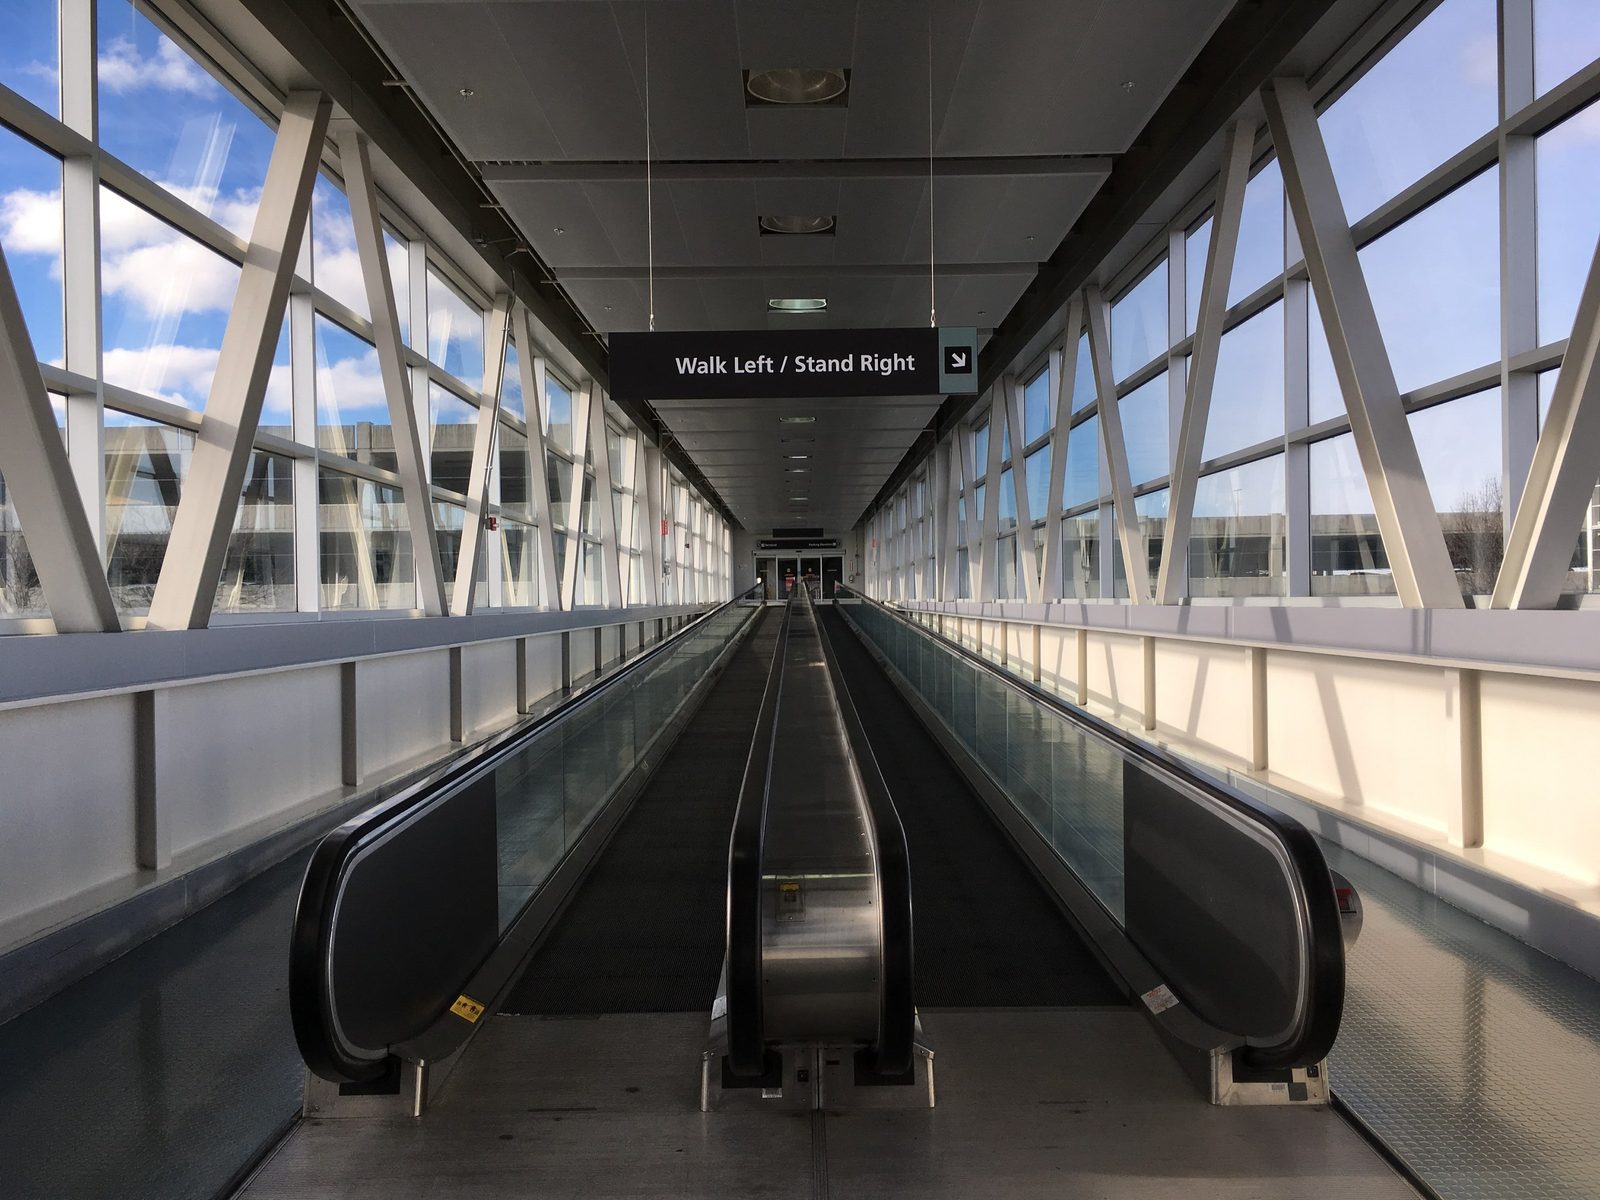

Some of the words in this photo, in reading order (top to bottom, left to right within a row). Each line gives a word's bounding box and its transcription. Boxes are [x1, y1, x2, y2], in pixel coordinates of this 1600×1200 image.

[675, 356, 728, 375] Walk
[734, 355, 774, 374] Left
[779, 355, 788, 374] /
[794, 353, 854, 373] Stand
[860, 353, 916, 376] Right
